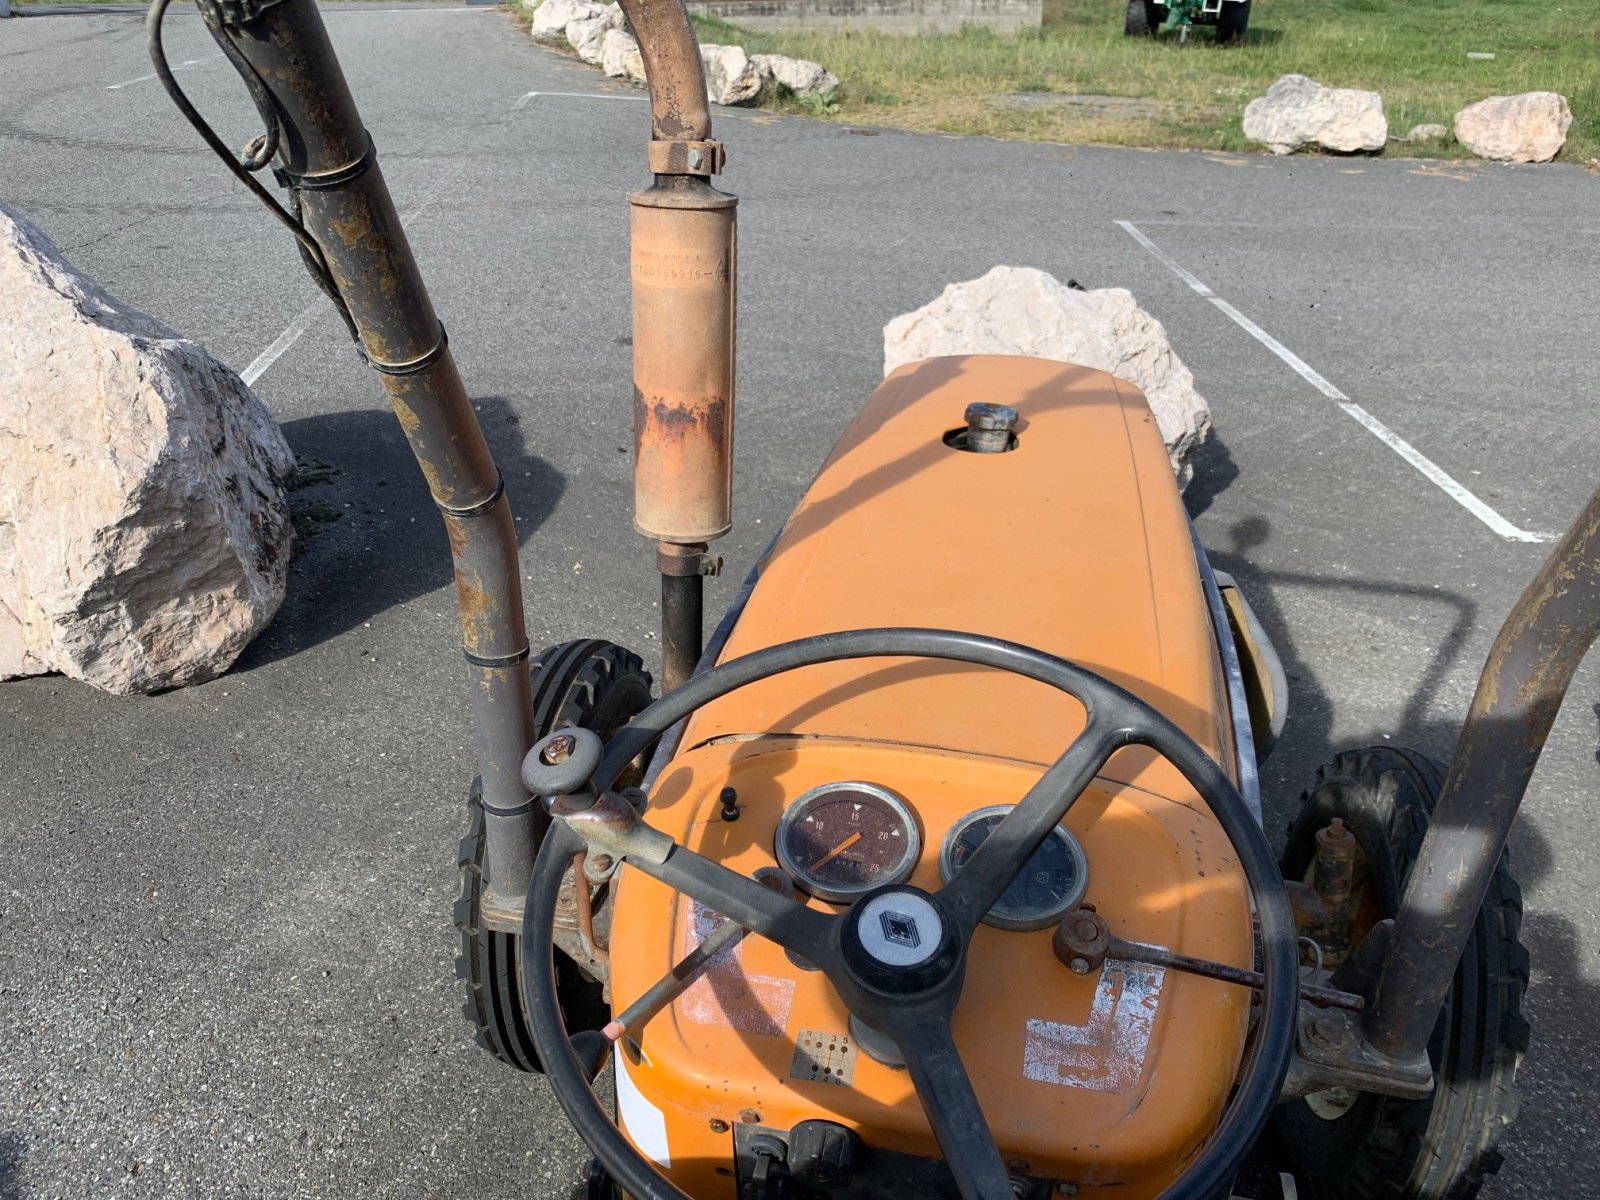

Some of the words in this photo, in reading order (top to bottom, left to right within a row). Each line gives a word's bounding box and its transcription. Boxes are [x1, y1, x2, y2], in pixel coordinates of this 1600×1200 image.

[851, 812, 860, 820] 15
[815, 821, 824, 830] 10
[878, 831, 889, 840] 20
[869, 863, 880, 873] 25
[811, 1073, 817, 1081] 2
[823, 1076, 829, 1084] 4
[835, 1078, 841, 1086] 6
